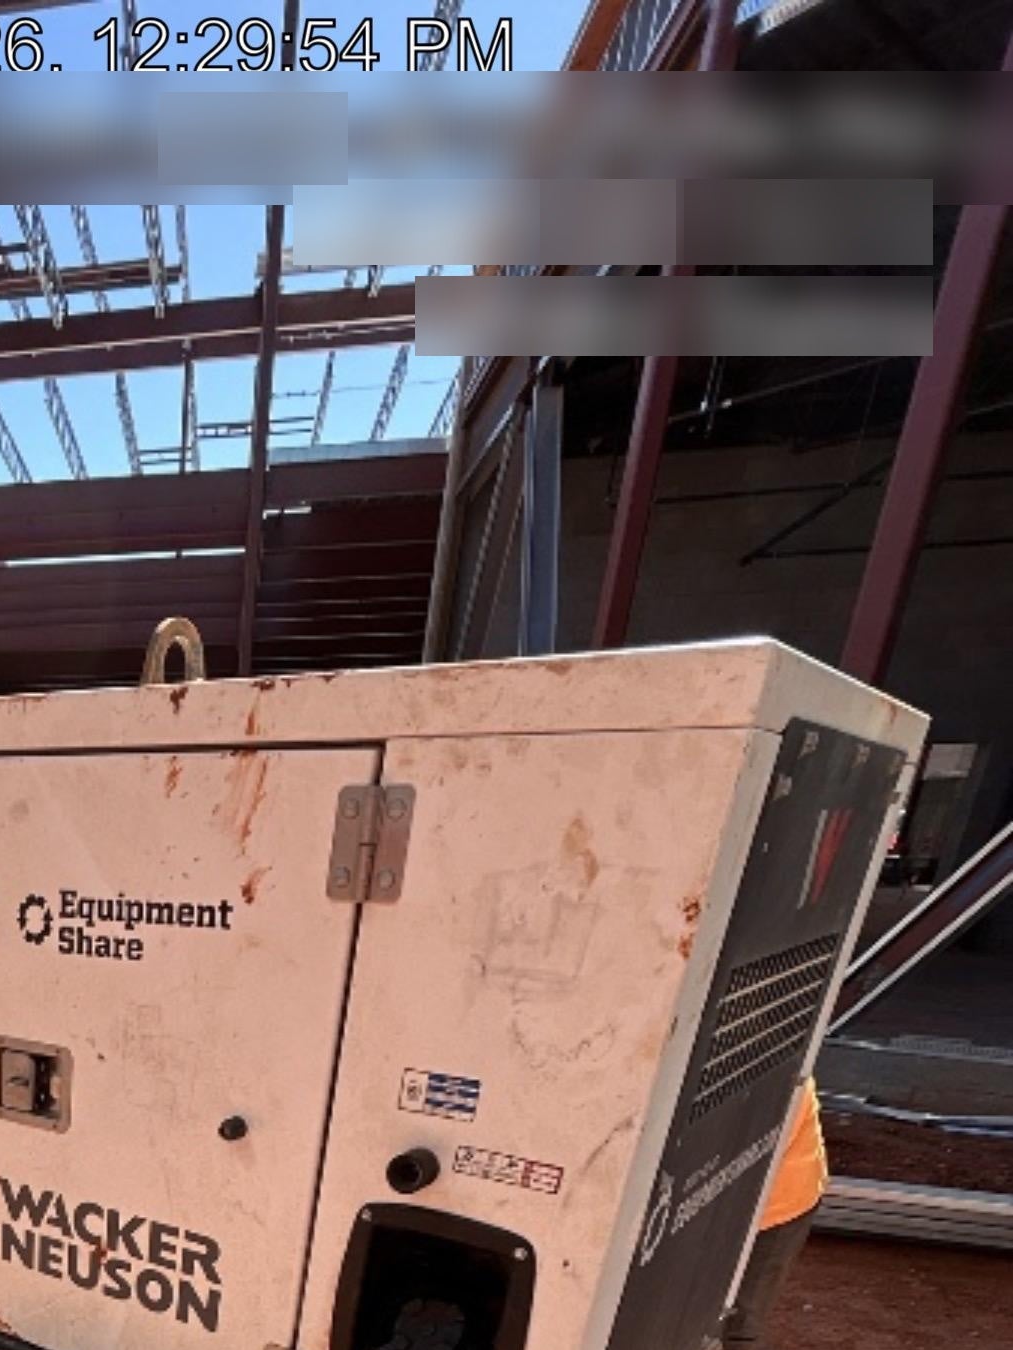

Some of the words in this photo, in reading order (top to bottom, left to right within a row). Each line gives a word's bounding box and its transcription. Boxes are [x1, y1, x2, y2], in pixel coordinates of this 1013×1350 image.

[58, 890, 233, 930] Equipment
[58, 926, 144, 961] Share
[0, 1176, 222, 1285] WACKER
[1, 1222, 222, 1332] NEUSON
